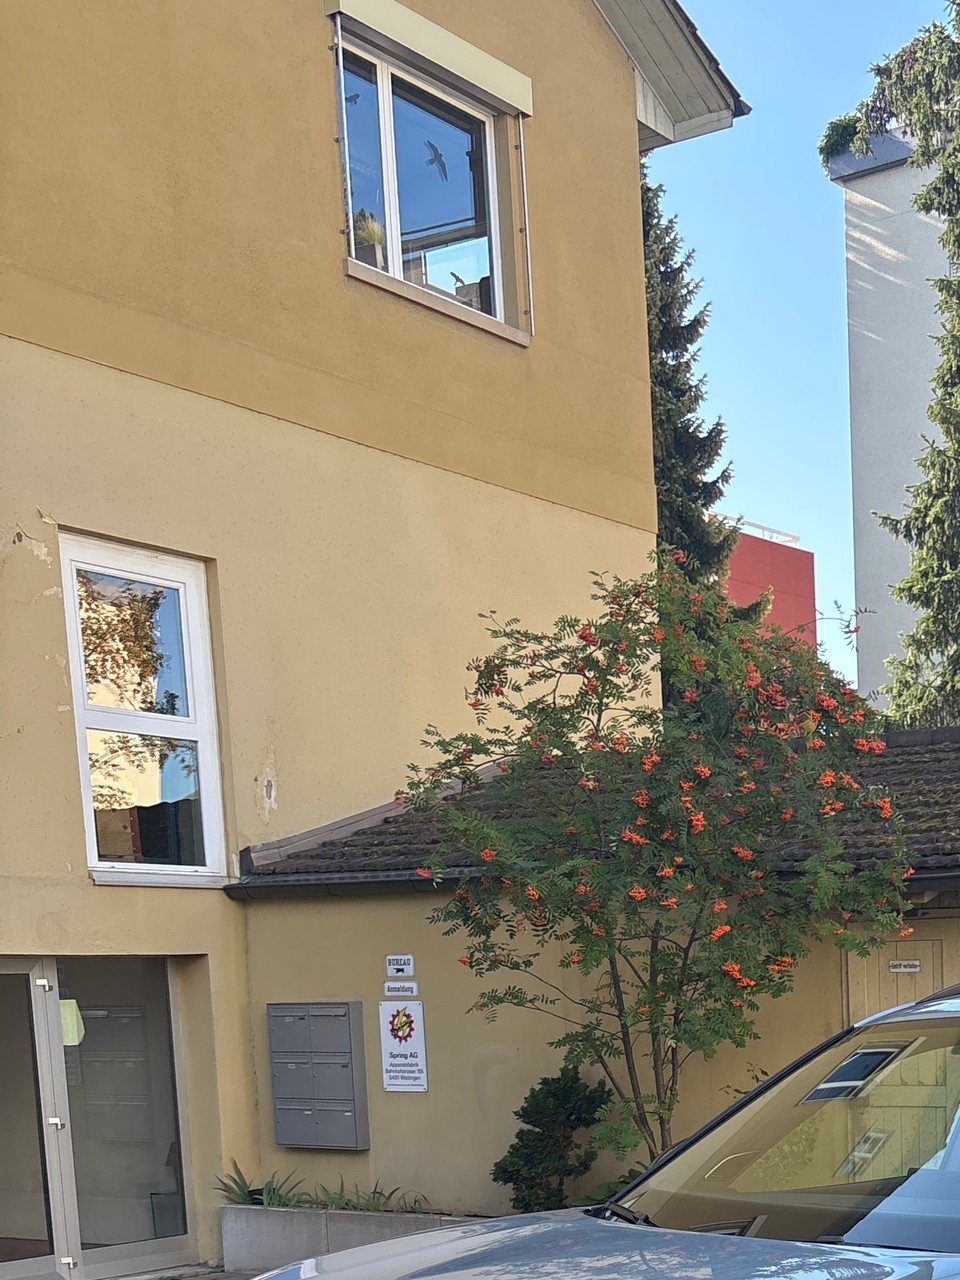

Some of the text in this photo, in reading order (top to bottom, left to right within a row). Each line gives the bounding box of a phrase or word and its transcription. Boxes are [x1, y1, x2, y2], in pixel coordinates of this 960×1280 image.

[387, 958, 411, 967] BUREAU
[389, 1051, 418, 1060] Spring AG
